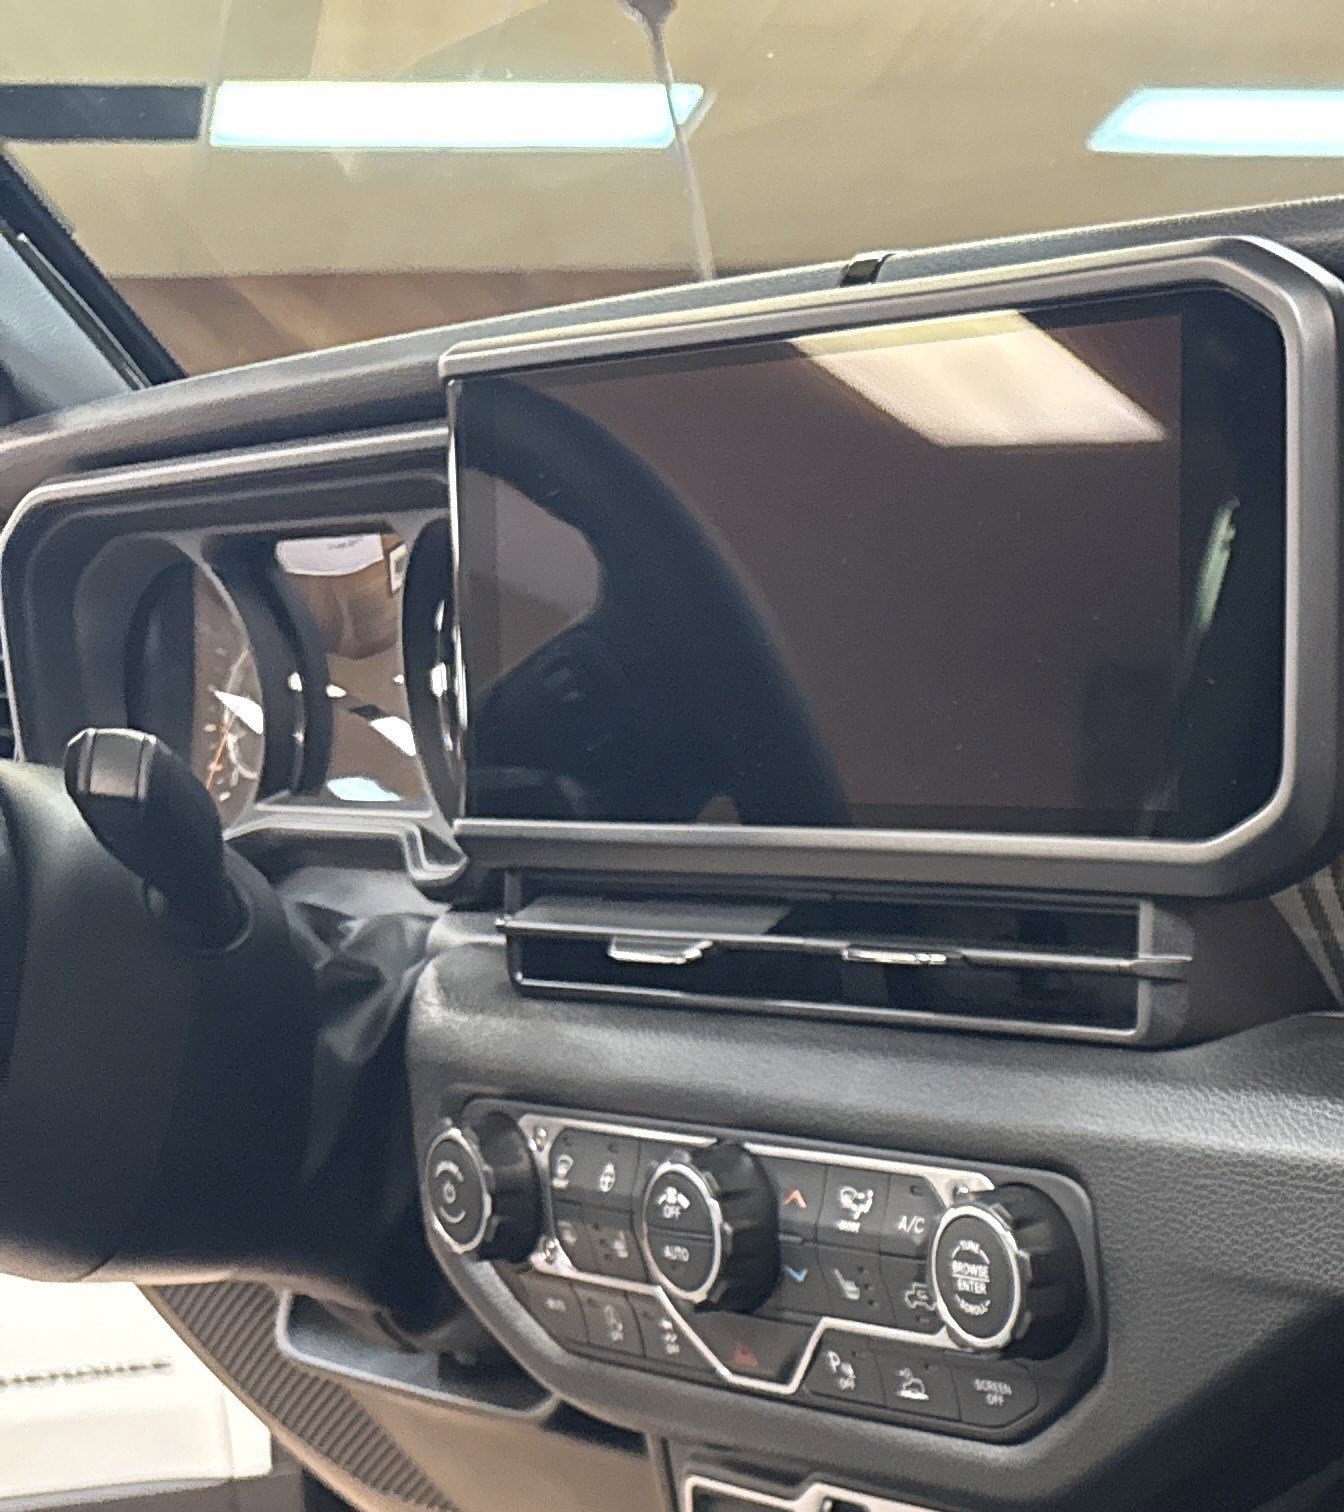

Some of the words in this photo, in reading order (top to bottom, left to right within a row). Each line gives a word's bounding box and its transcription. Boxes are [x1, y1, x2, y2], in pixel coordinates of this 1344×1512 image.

[898, 1215, 925, 1234] A/C
[664, 1244, 690, 1262] AUTO
[952, 1259, 989, 1278] BROWSE
[957, 1277, 988, 1296] ENTER
